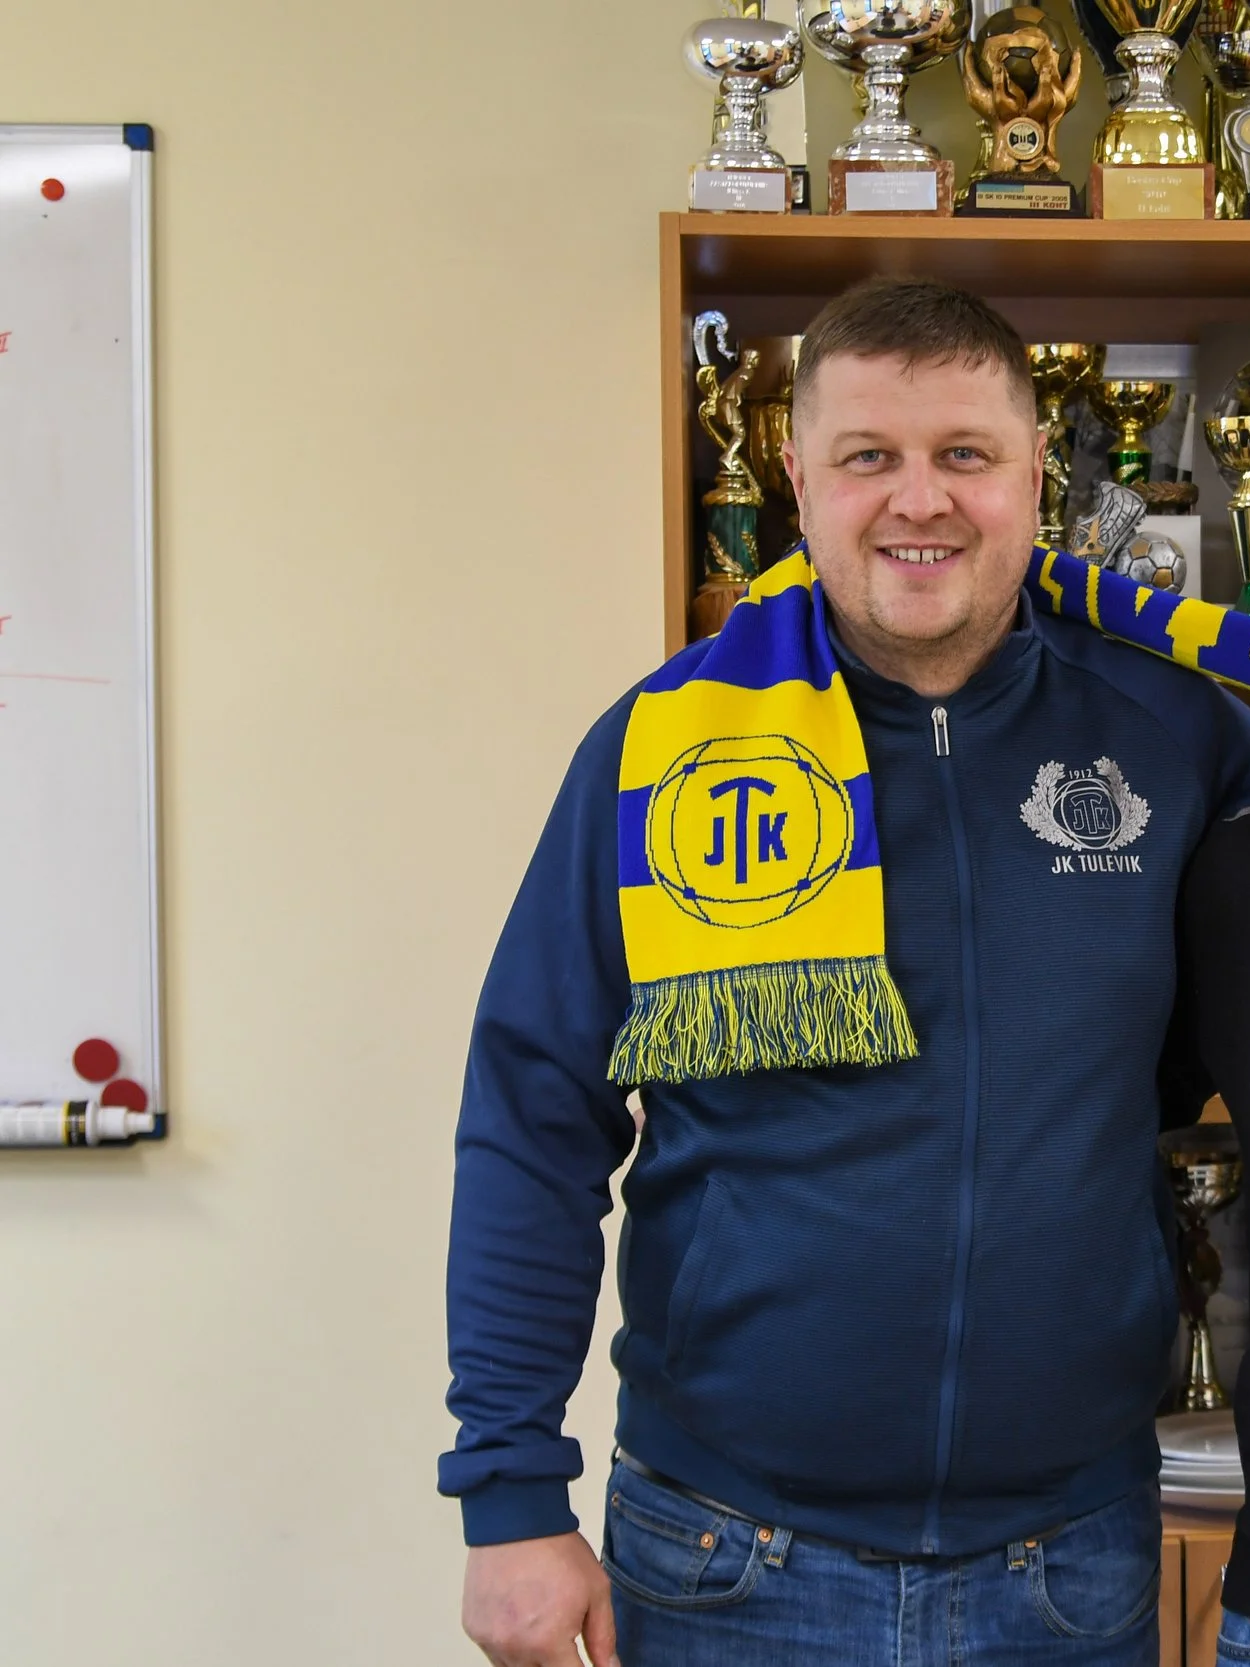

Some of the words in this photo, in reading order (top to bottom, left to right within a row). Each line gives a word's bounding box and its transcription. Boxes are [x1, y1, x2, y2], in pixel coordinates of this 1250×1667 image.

[1068, 768, 1093, 780] 1912
[1051, 855, 1075, 874] JK
[1078, 854, 1143, 873] TULEVIK
